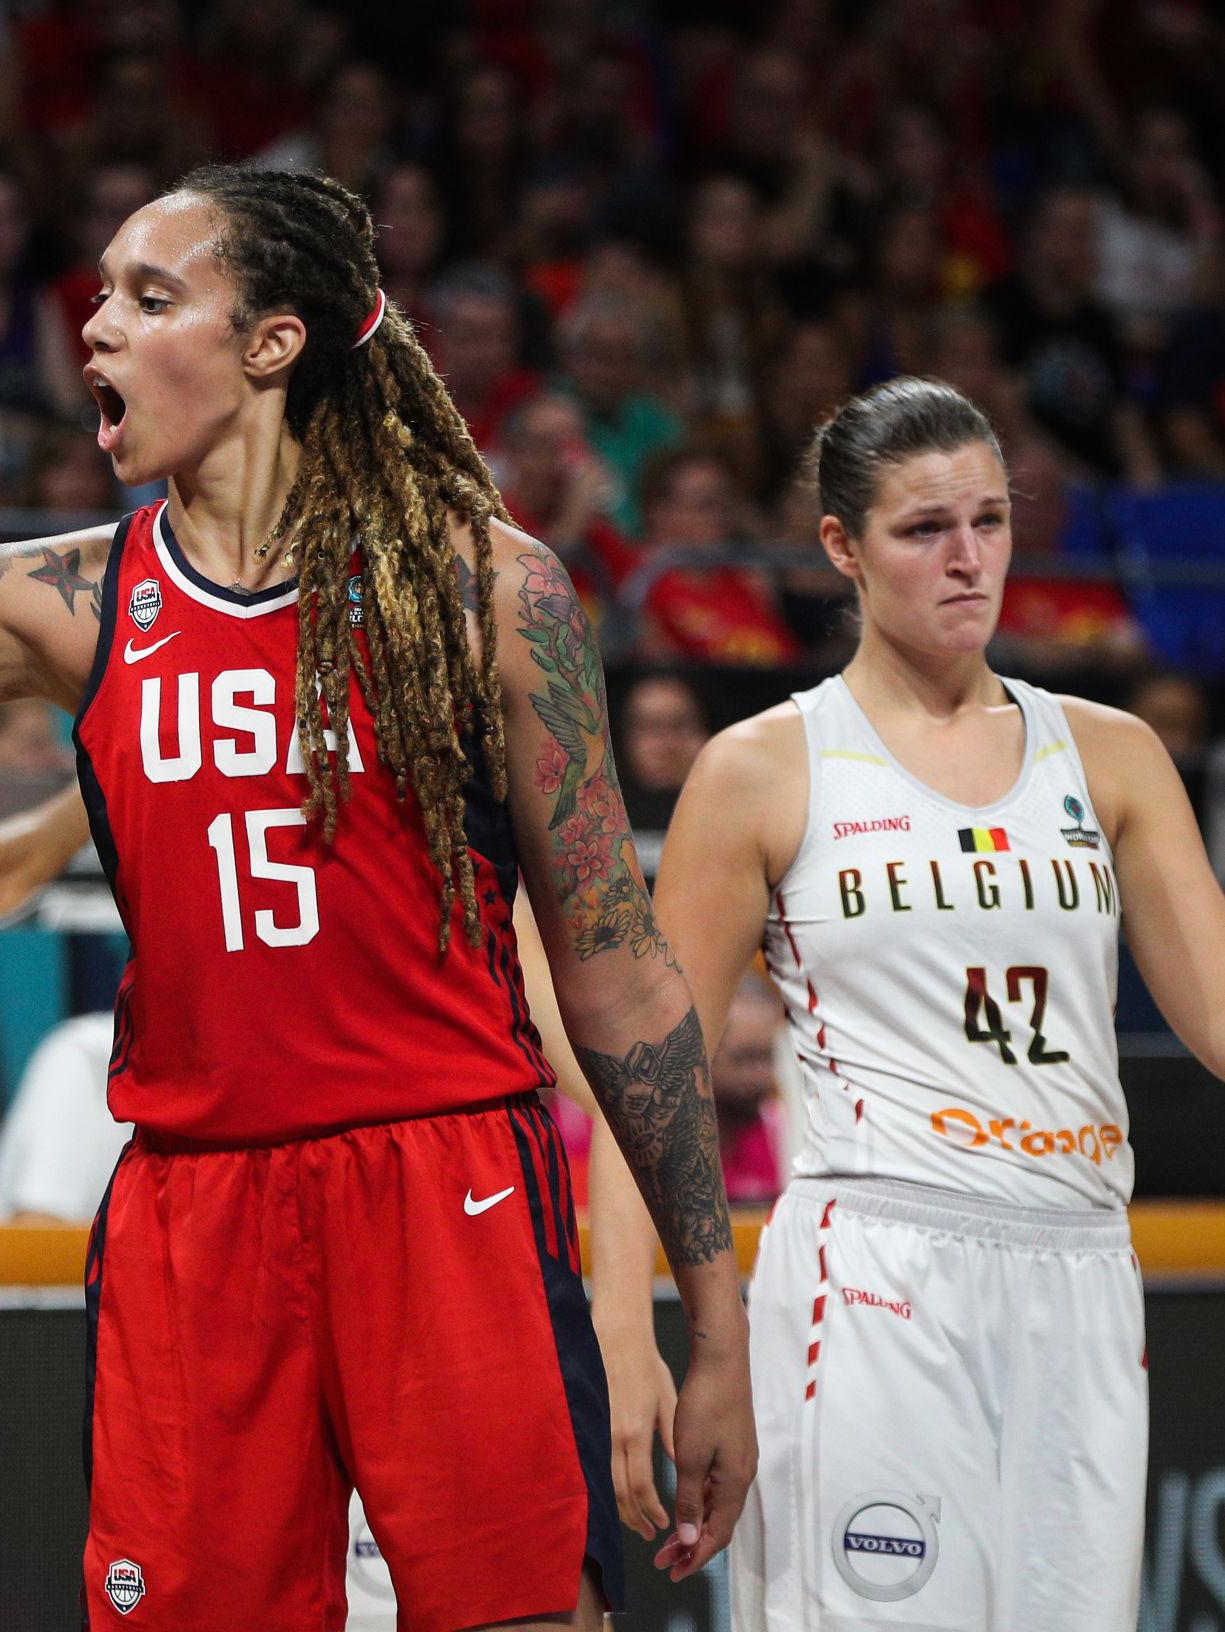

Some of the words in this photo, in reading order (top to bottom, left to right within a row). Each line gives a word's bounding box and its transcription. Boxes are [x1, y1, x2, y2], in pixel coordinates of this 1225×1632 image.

[136, 587, 156, 602] USA
[140, 668, 366, 784] USA
[832, 815, 911, 841] SPALDING
[207, 808, 320, 952] 15
[837, 859, 1117, 920] BELGIUM
[964, 966, 1070, 1066] 42
[930, 1108, 1125, 1166] Orange
[847, 1535, 923, 1556] VOLVO
[113, 1569, 137, 1583] USA
